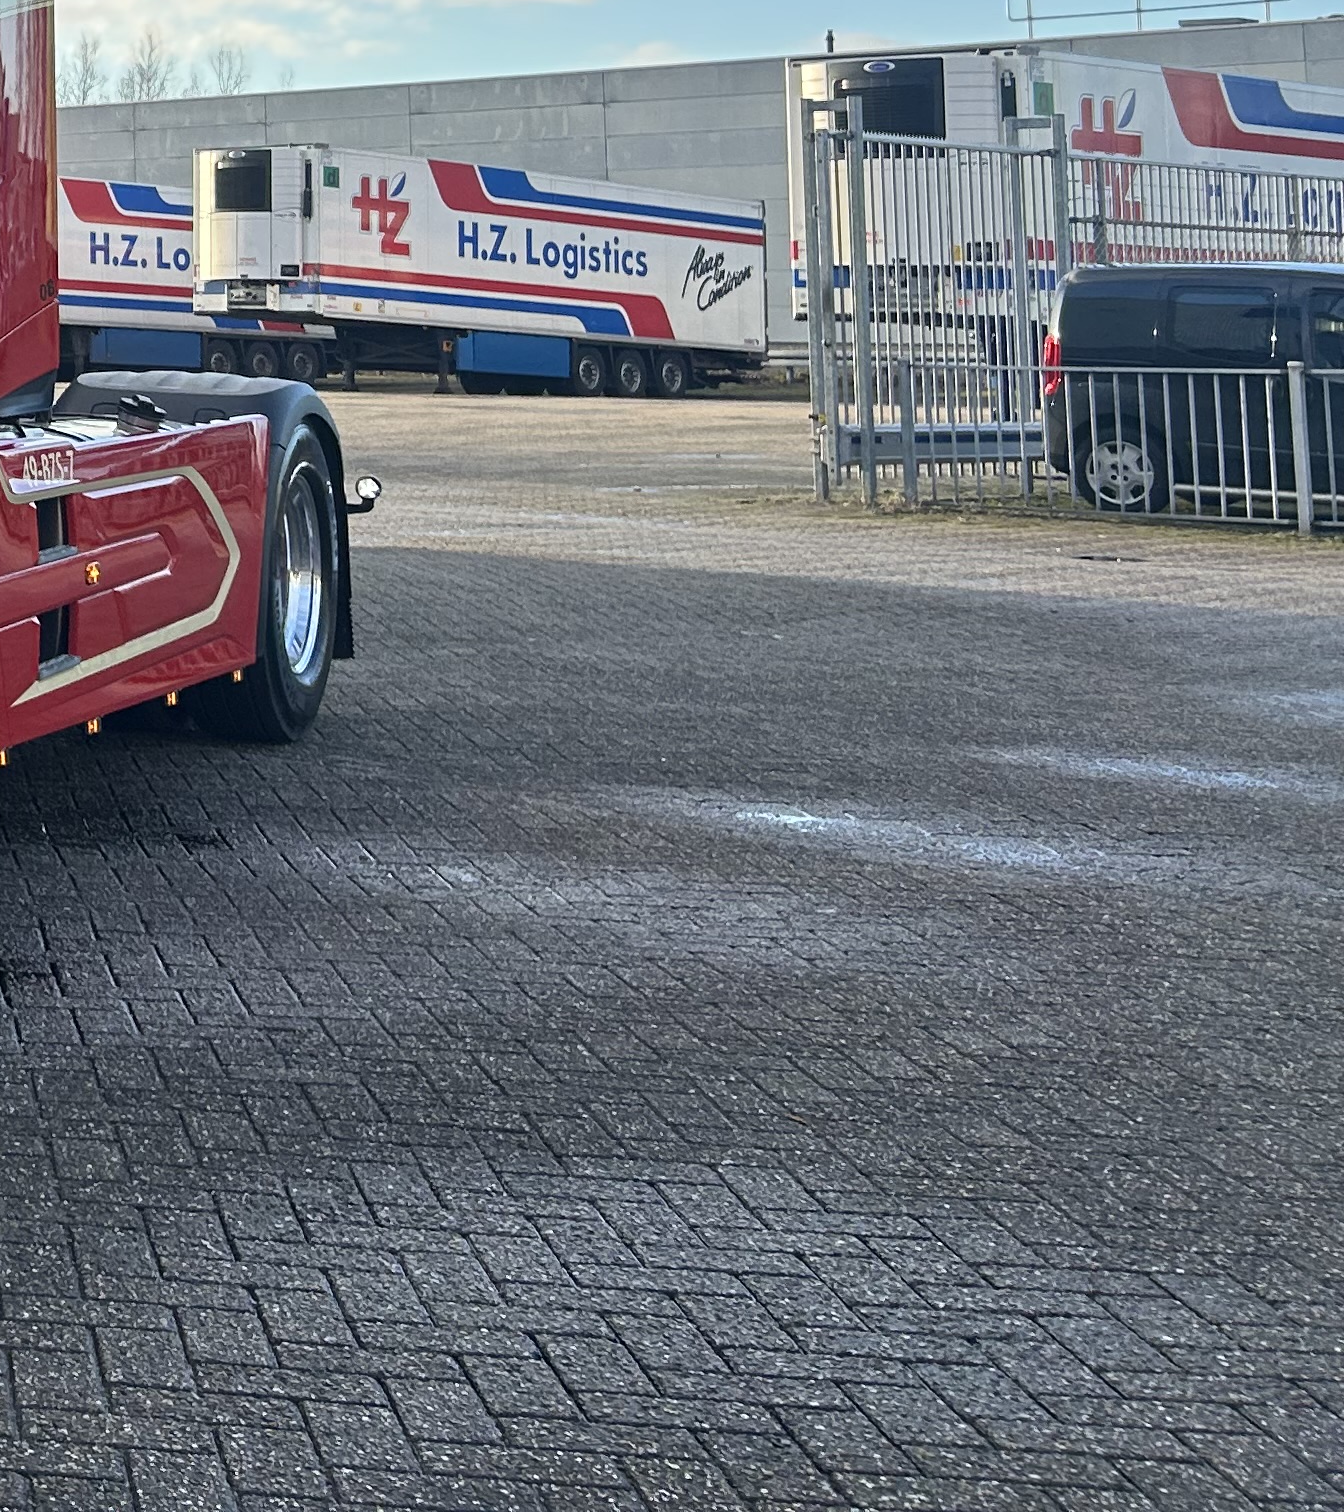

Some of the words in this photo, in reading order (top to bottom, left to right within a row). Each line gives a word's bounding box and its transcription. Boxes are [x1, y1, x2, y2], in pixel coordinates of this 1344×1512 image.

[89, 231, 148, 269] H.Z.
[457, 220, 517, 264] H.Z.
[525, 227, 648, 279] Logistics
